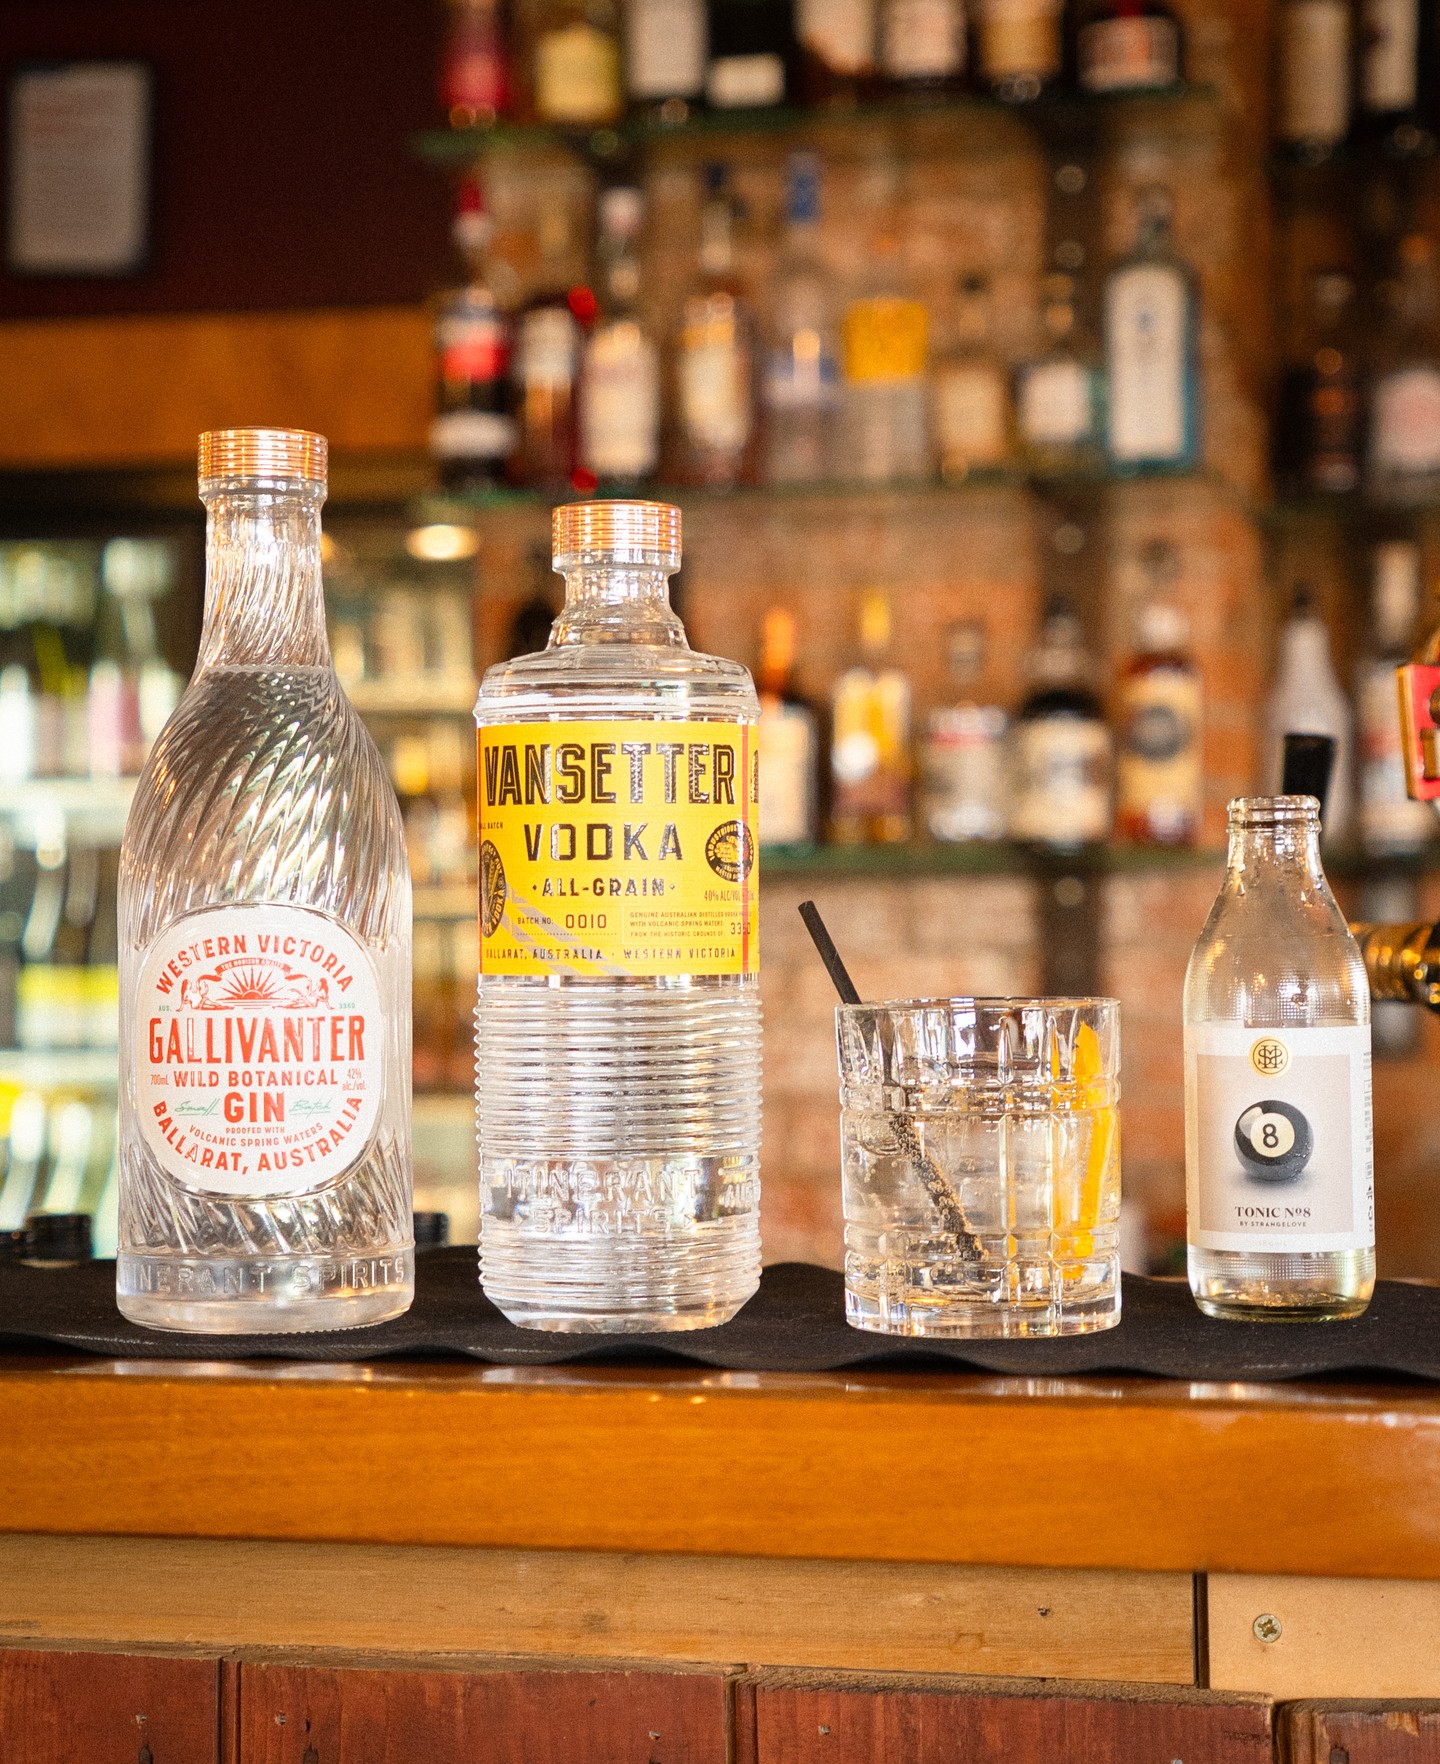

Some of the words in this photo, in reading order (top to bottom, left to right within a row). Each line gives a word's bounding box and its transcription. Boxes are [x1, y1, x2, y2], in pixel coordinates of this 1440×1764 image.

[484, 743, 735, 806] VANSETTER
[487, 821, 503, 830] BATCH
[523, 822, 684, 861] VODKA
[541, 877, 666, 897] ALL-GRAIN
[703, 890, 719, 901] 40%
[517, 917, 540, 925] BATCH
[565, 914, 607, 929] 0010
[532, 948, 602, 960] AUSTRALIA
[688, 948, 736, 959] VICTORIA
[156, 934, 247, 995] WESTERN
[257, 934, 353, 993] VICTORIA
[149, 1015, 365, 1064] GALLIVANTER
[173, 1070, 219, 1088] WILD
[228, 1068, 338, 1088] BOTANICAL
[175, 1098, 220, 1116] Small
[223, 1091, 285, 1123] GIN
[153, 1100, 249, 1175] BALLARAT,
[257, 1097, 362, 1172] AUSTRALIA
[189, 1125, 237, 1147] VOLCANIC
[240, 1137, 279, 1147] SPRING
[283, 1122, 323, 1145] WATERS
[225, 1127, 262, 1135] PROOFED
[264, 1126, 285, 1134] WITH
[1262, 1123, 1279, 1149] 8
[1234, 1206, 1281, 1218] TONIC
[292, 1257, 405, 1291] SPIRITS
